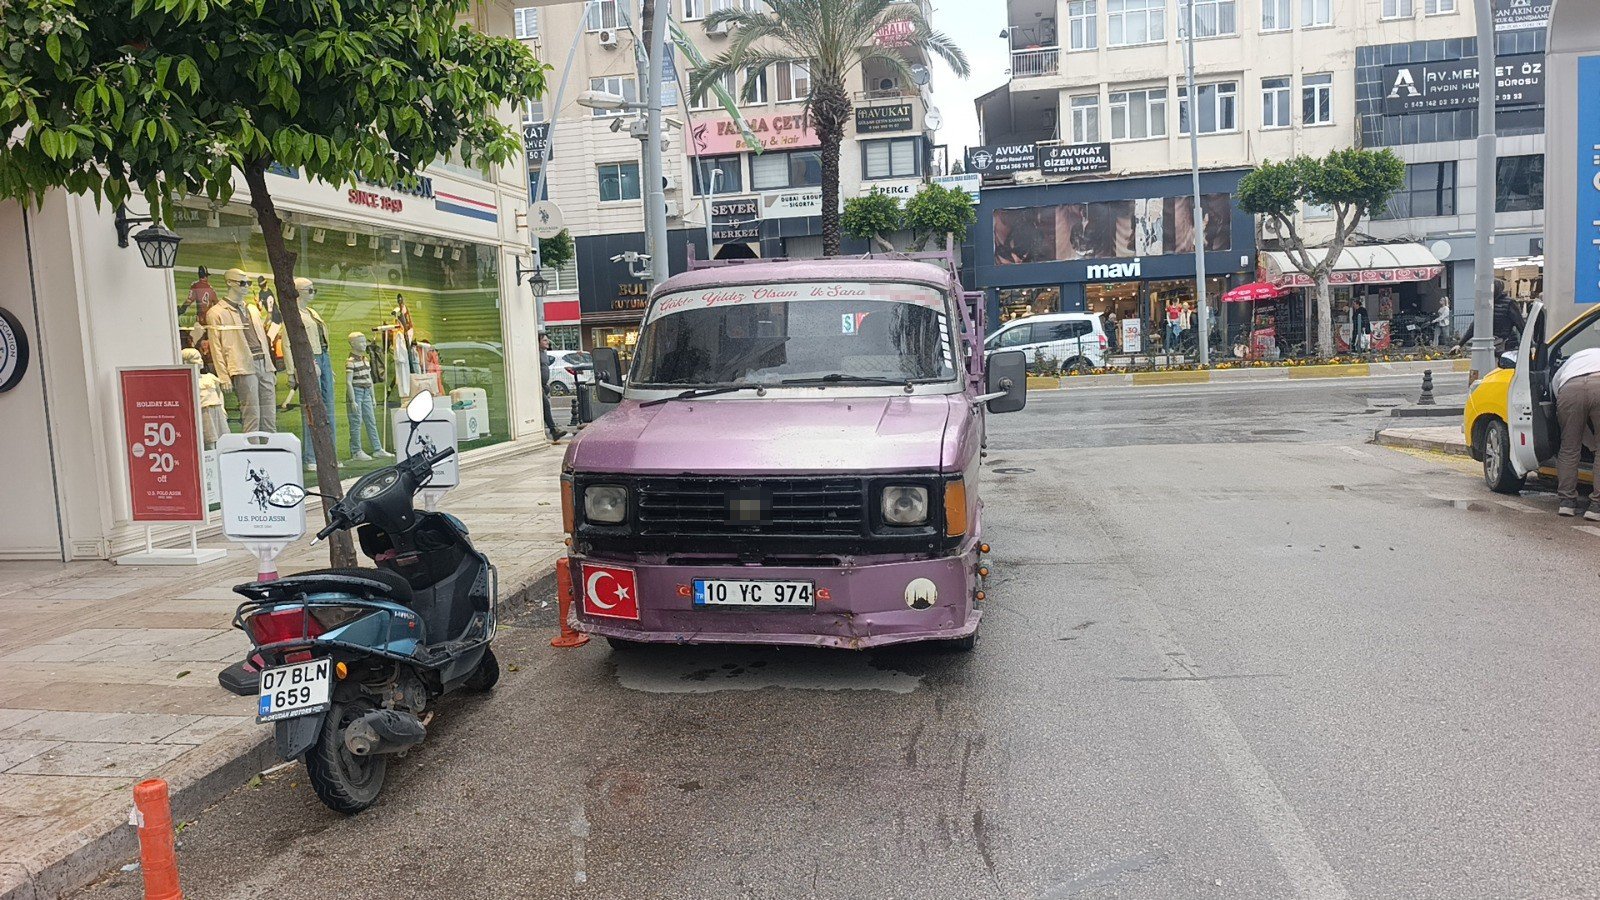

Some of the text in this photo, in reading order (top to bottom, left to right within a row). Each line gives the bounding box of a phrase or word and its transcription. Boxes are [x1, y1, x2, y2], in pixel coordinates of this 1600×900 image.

[1521, 62, 1542, 75] ÖZ
[1430, 83, 1458, 93] AYDIN
[868, 106, 910, 118] AVUKAT
[770, 136, 779, 146] &
[781, 134, 800, 145] Hair
[995, 144, 1034, 156] AVUKAT
[1060, 146, 1101, 157] AVUKAT
[1044, 156, 1107, 167] GİZEM VURAL
[880, 185, 909, 194] PERGE
[348, 188, 379, 209] SINCE
[711, 203, 757, 216] SEVER
[1086, 258, 1141, 279] mavi
[157, 475, 167, 483] off
[706, 583, 810, 603] 10 YC 974
[264, 663, 327, 690] 07 BLN
[275, 686, 311, 708] 659
